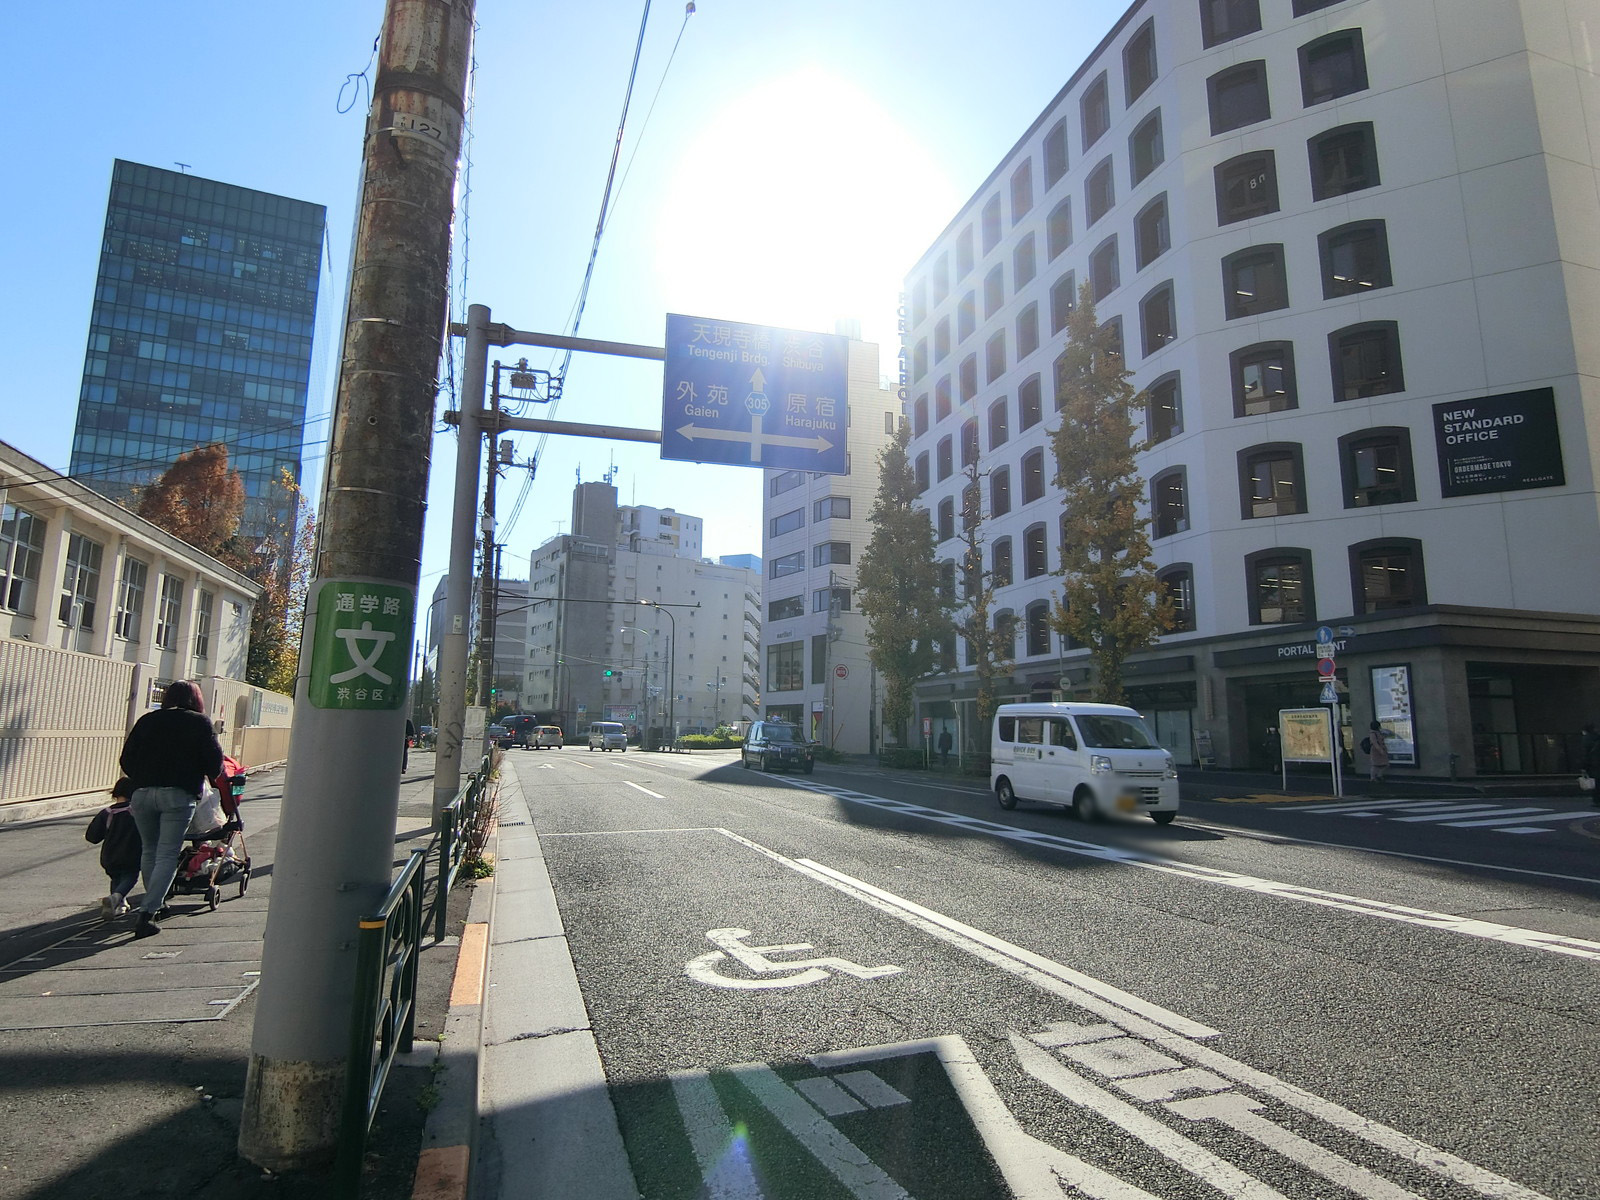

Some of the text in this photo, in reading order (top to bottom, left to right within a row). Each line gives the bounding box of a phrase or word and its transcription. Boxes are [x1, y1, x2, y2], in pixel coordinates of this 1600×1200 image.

[411, 120, 441, 138] 127
[691, 323, 825, 359] 天現寺橋 渋谷
[687, 344, 824, 372] Tengenji Brdg. Shibuya
[676, 380, 728, 406] 外苑
[684, 404, 719, 418] Gaien
[748, 397, 767, 410] 305
[787, 393, 835, 417] 原宿
[785, 415, 836, 431] Harajuku
[1443, 409, 1475, 421] NEW
[1444, 414, 1524, 434] STANDARD
[1446, 429, 1499, 445] OFFICE
[1492, 460, 1512, 469] TOKYO
[335, 593, 401, 616] 通学路
[330, 620, 396, 685] 文
[1278, 644, 1315, 657] PORTAL
[337, 687, 384, 701] 渋谷区
